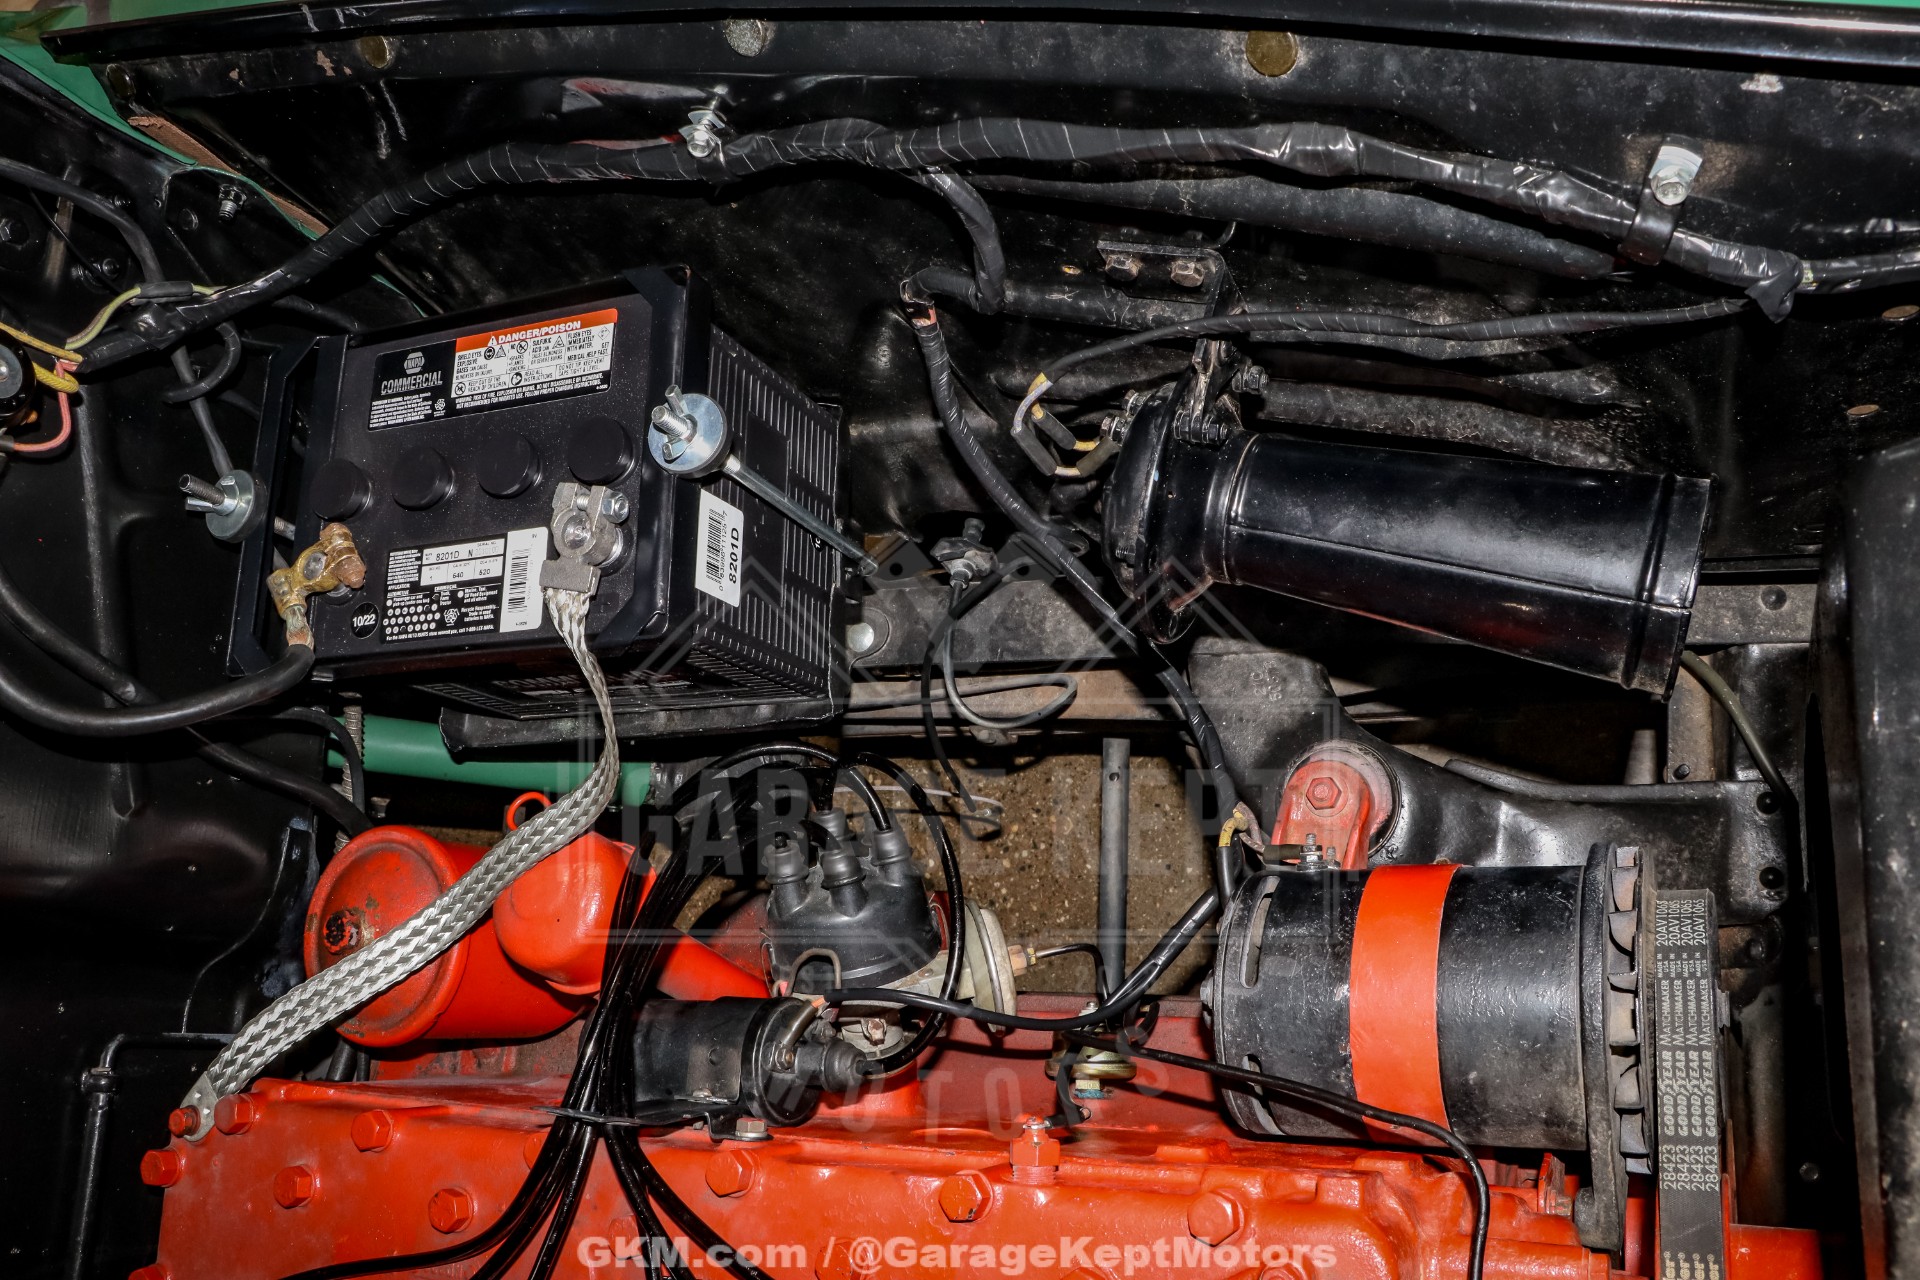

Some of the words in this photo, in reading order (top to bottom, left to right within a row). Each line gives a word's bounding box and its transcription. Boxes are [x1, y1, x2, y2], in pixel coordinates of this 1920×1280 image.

[497, 320, 580, 344] DANGER/POISON
[380, 370, 443, 394] COMMERCIAL
[435, 549, 459, 561] 8201D
[729, 527, 739, 584] 8201D
[352, 613, 376, 628] 10/22
[1656, 900, 1668, 947] 20AV1065
[1669, 900, 1680, 947] 20AV1065
[1681, 899, 1693, 946] 20AV1065
[1693, 898, 1706, 946] 20AV1065
[1660, 1051, 1676, 1136] GOODYEAR
[1673, 1051, 1690, 1137] GOODYEAR
[1686, 1050, 1703, 1137] GOODYEAR
[1700, 1050, 1716, 1137] GOODYEAR
[1662, 1145, 1677, 1190] 28423
[1676, 1145, 1691, 1191] 28423
[1690, 1145, 1705, 1192] 28423
[1704, 1146, 1719, 1192] 28423
